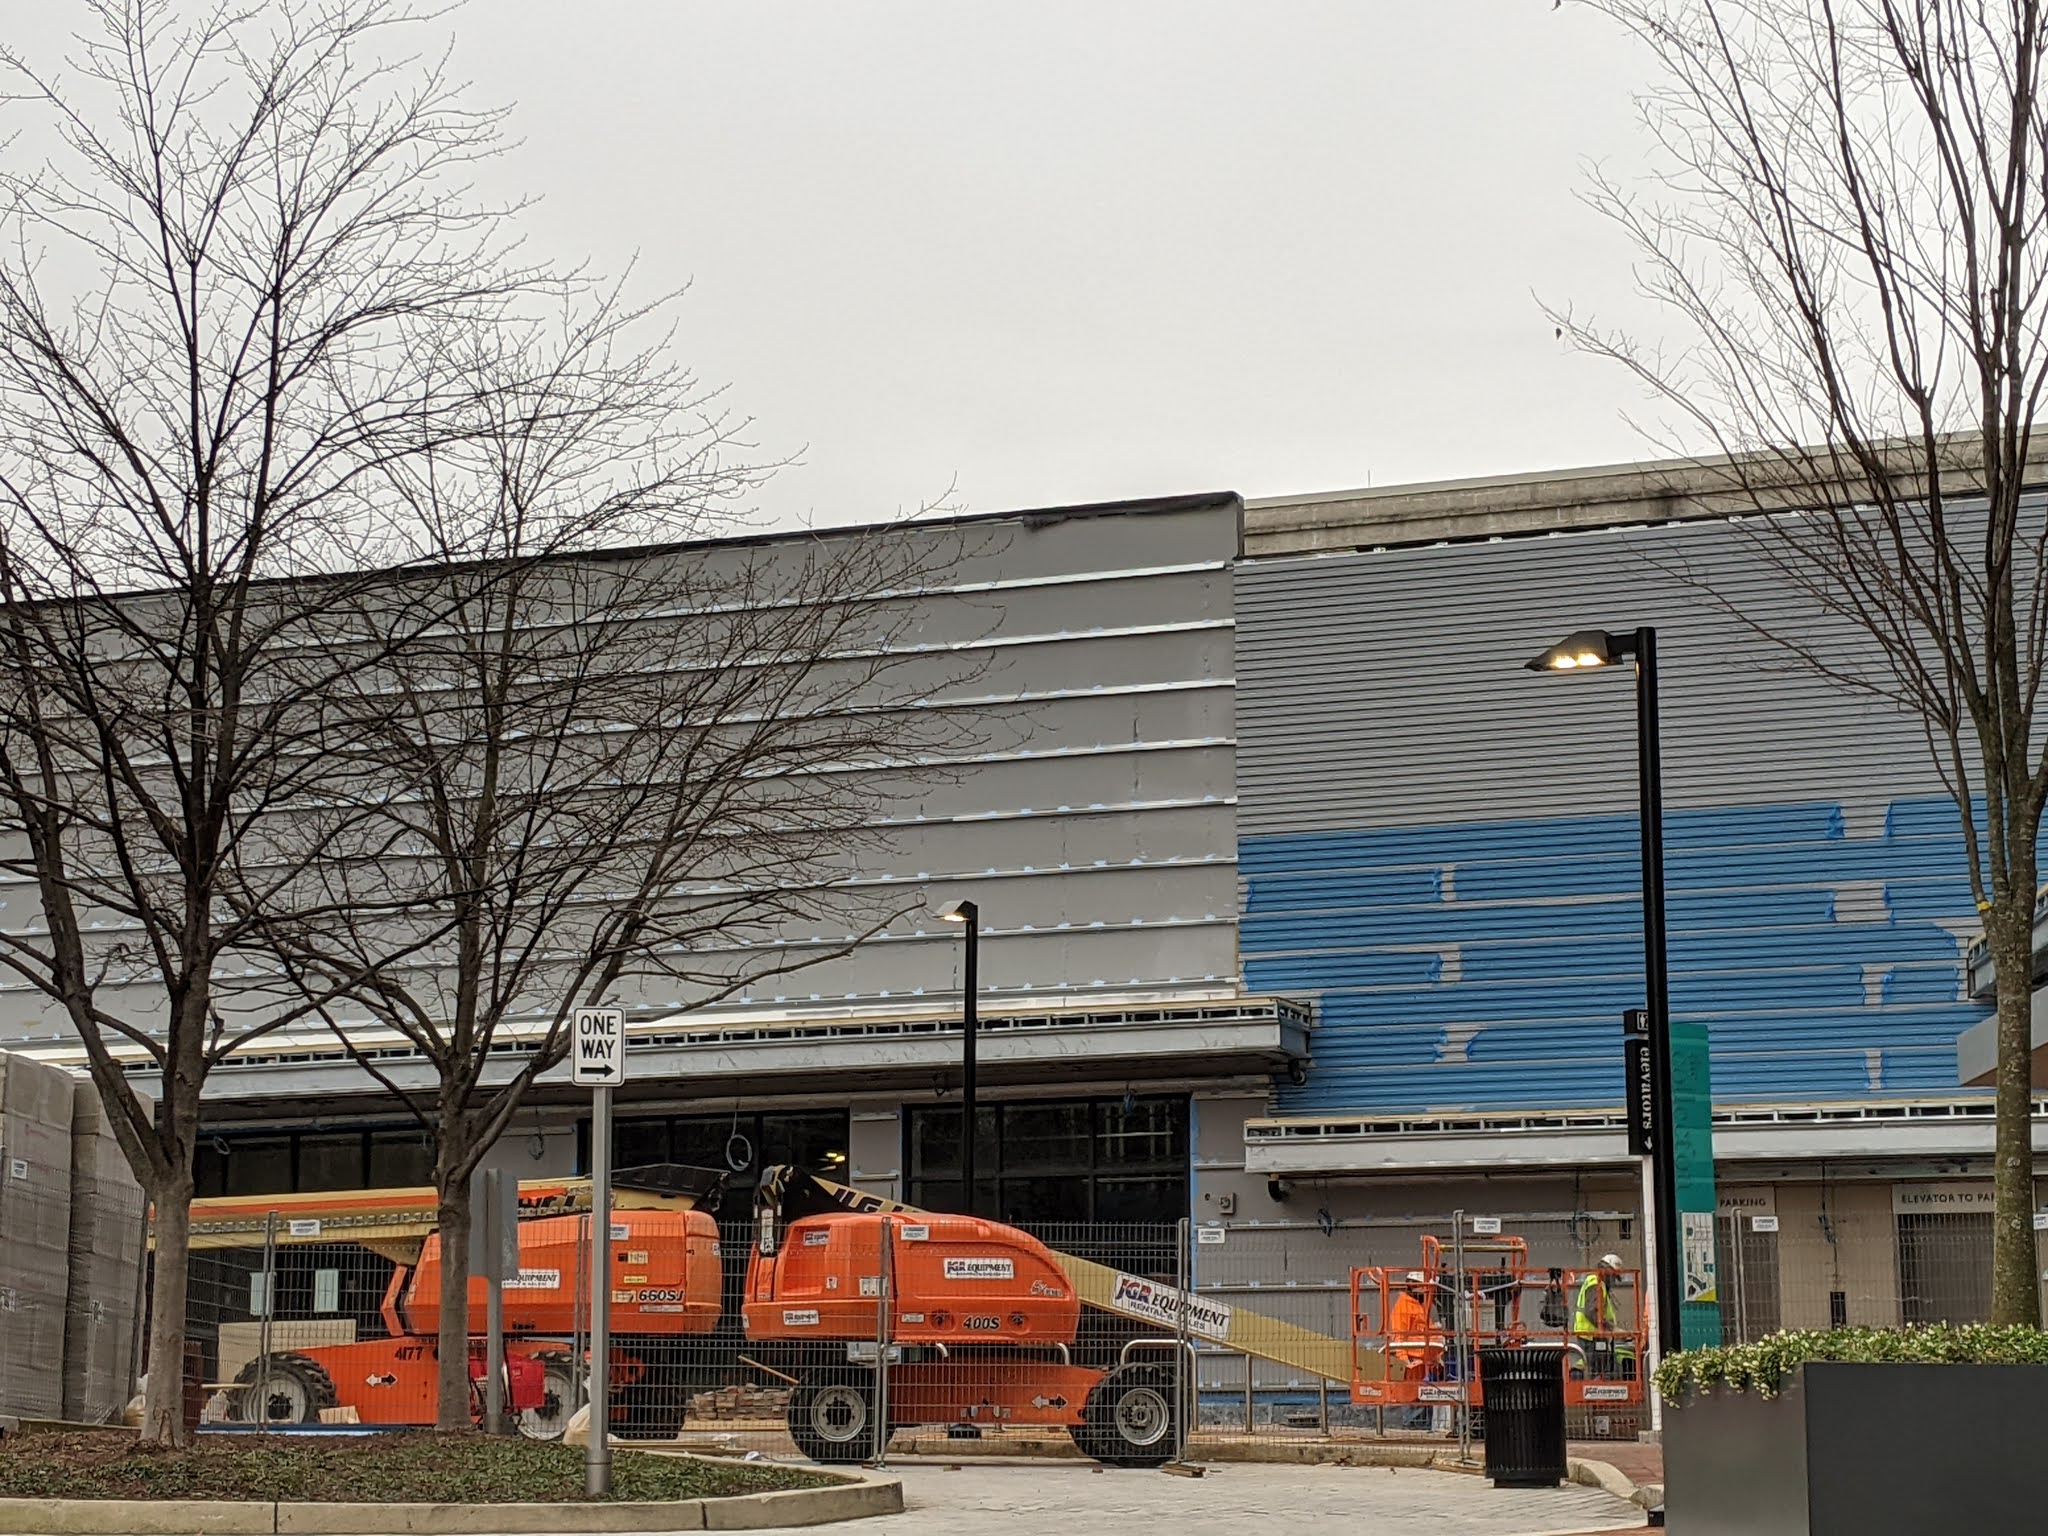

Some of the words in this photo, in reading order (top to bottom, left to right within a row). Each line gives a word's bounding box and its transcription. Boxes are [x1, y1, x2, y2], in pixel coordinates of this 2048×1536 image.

[580, 1014, 617, 1035] ONE
[580, 1039, 616, 1059] WAY
[1639, 1046, 1653, 1130] elevators
[1719, 1198, 1766, 1207] PARKING
[1901, 1192, 1956, 1204] ELEVATOR
[1957, 1193, 1973, 1203] TO
[947, 1261, 966, 1274] JGR
[967, 1263, 1012, 1274] EQUIPMENT
[514, 1273, 558, 1283] QUIPMENT
[638, 1289, 685, 1302] 660SJ
[1114, 1278, 1152, 1303] JGR
[963, 1316, 1000, 1330] 400S
